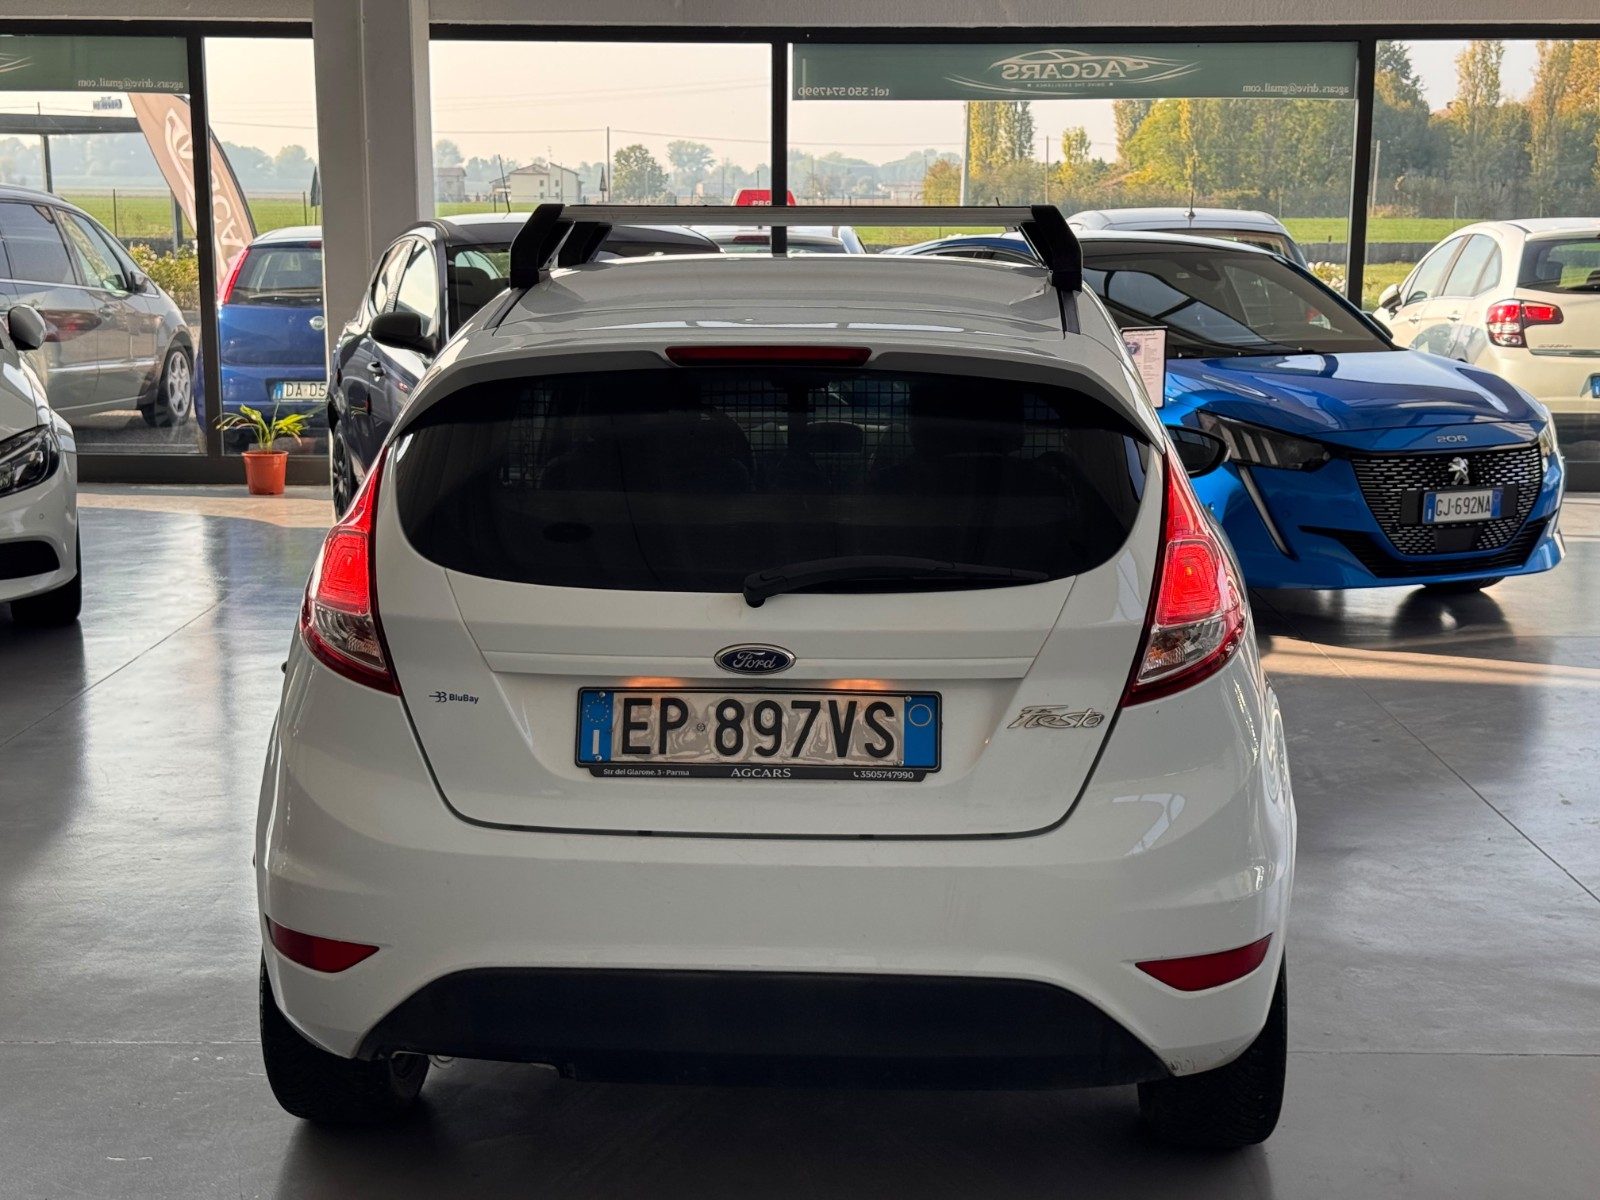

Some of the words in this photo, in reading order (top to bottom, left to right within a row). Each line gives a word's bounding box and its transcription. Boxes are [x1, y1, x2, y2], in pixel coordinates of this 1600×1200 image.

[732, 651, 777, 669] Ford
[449, 693, 479, 704] BluBay
[1006, 704, 1105, 729] Fiesta
[622, 697, 689, 755] EP
[715, 698, 895, 758] 897VS
[730, 768, 792, 778] AGCARS
[860, 770, 914, 779] 3505747990
